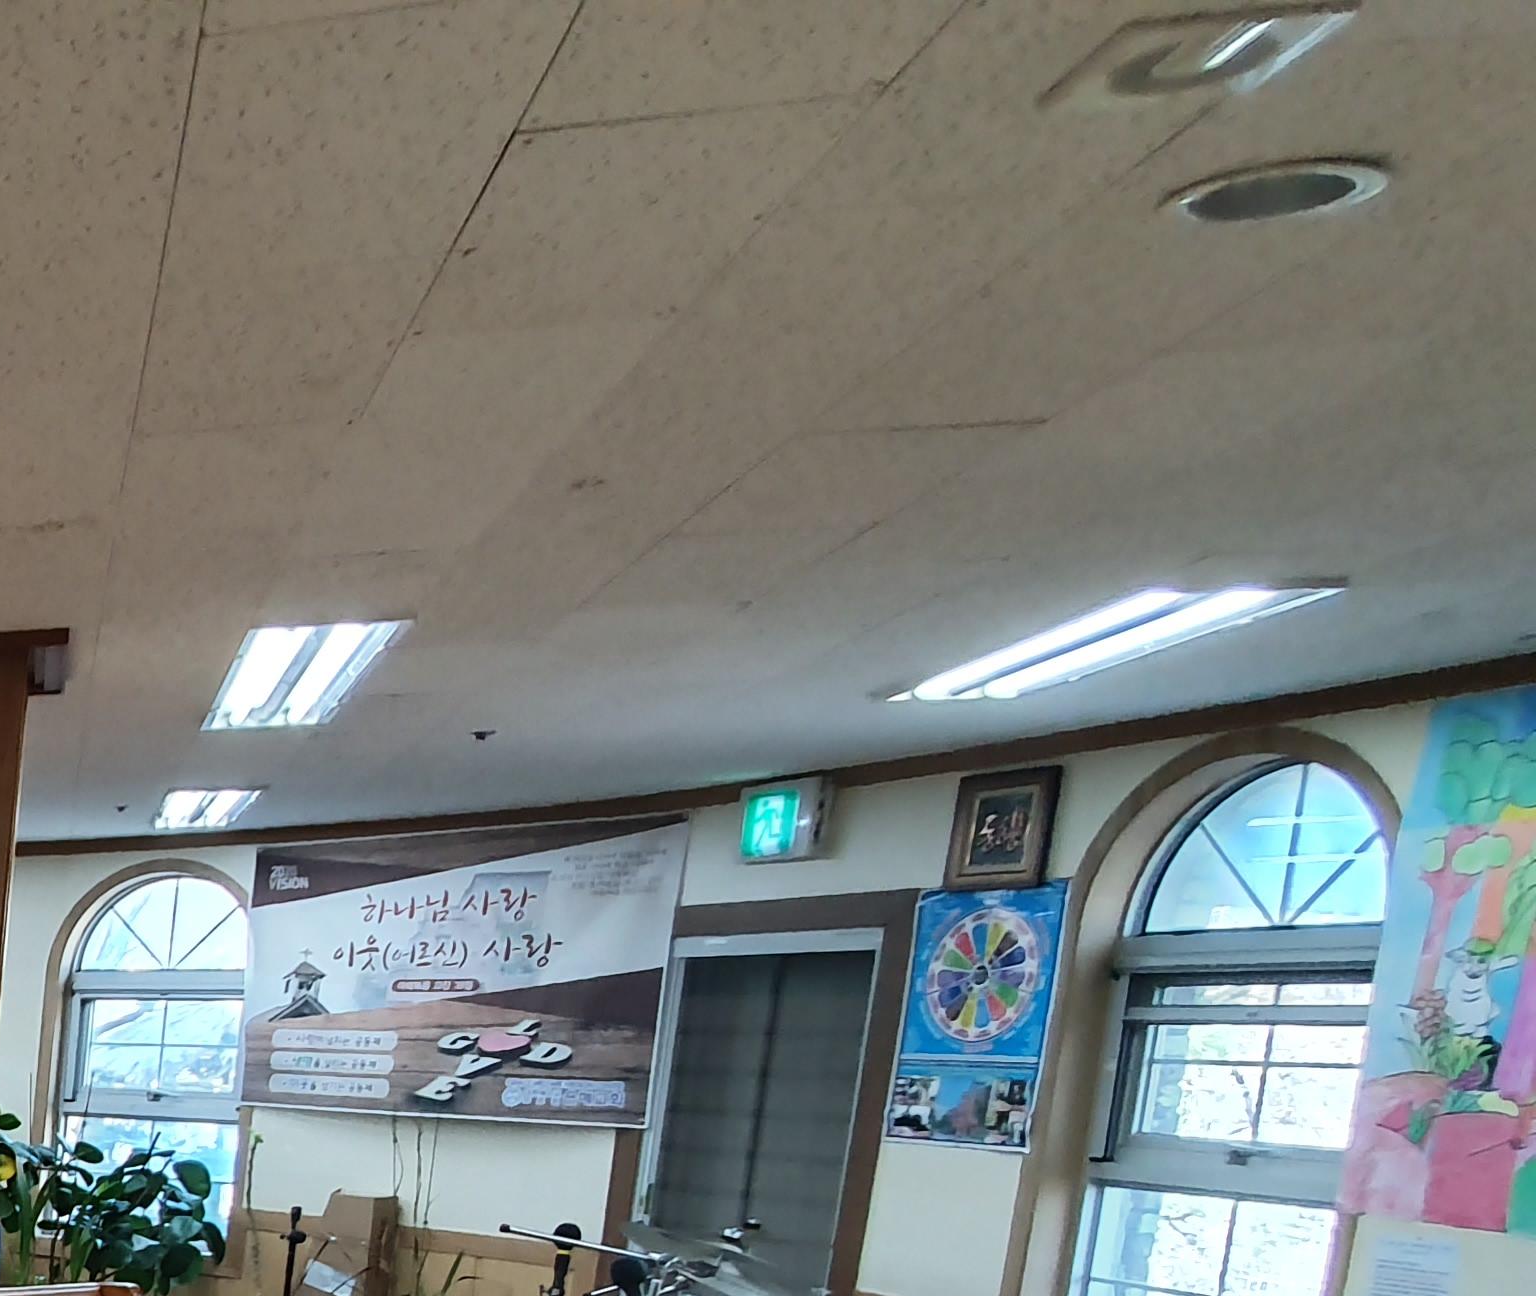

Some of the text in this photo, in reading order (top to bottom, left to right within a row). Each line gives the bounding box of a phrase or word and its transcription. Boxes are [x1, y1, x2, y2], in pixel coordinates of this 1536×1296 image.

[269, 876, 310, 890] VISION
[361, 887, 538, 923] 하나님 사랑
[333, 933, 565, 971] 이웃(어르신) 사랑
